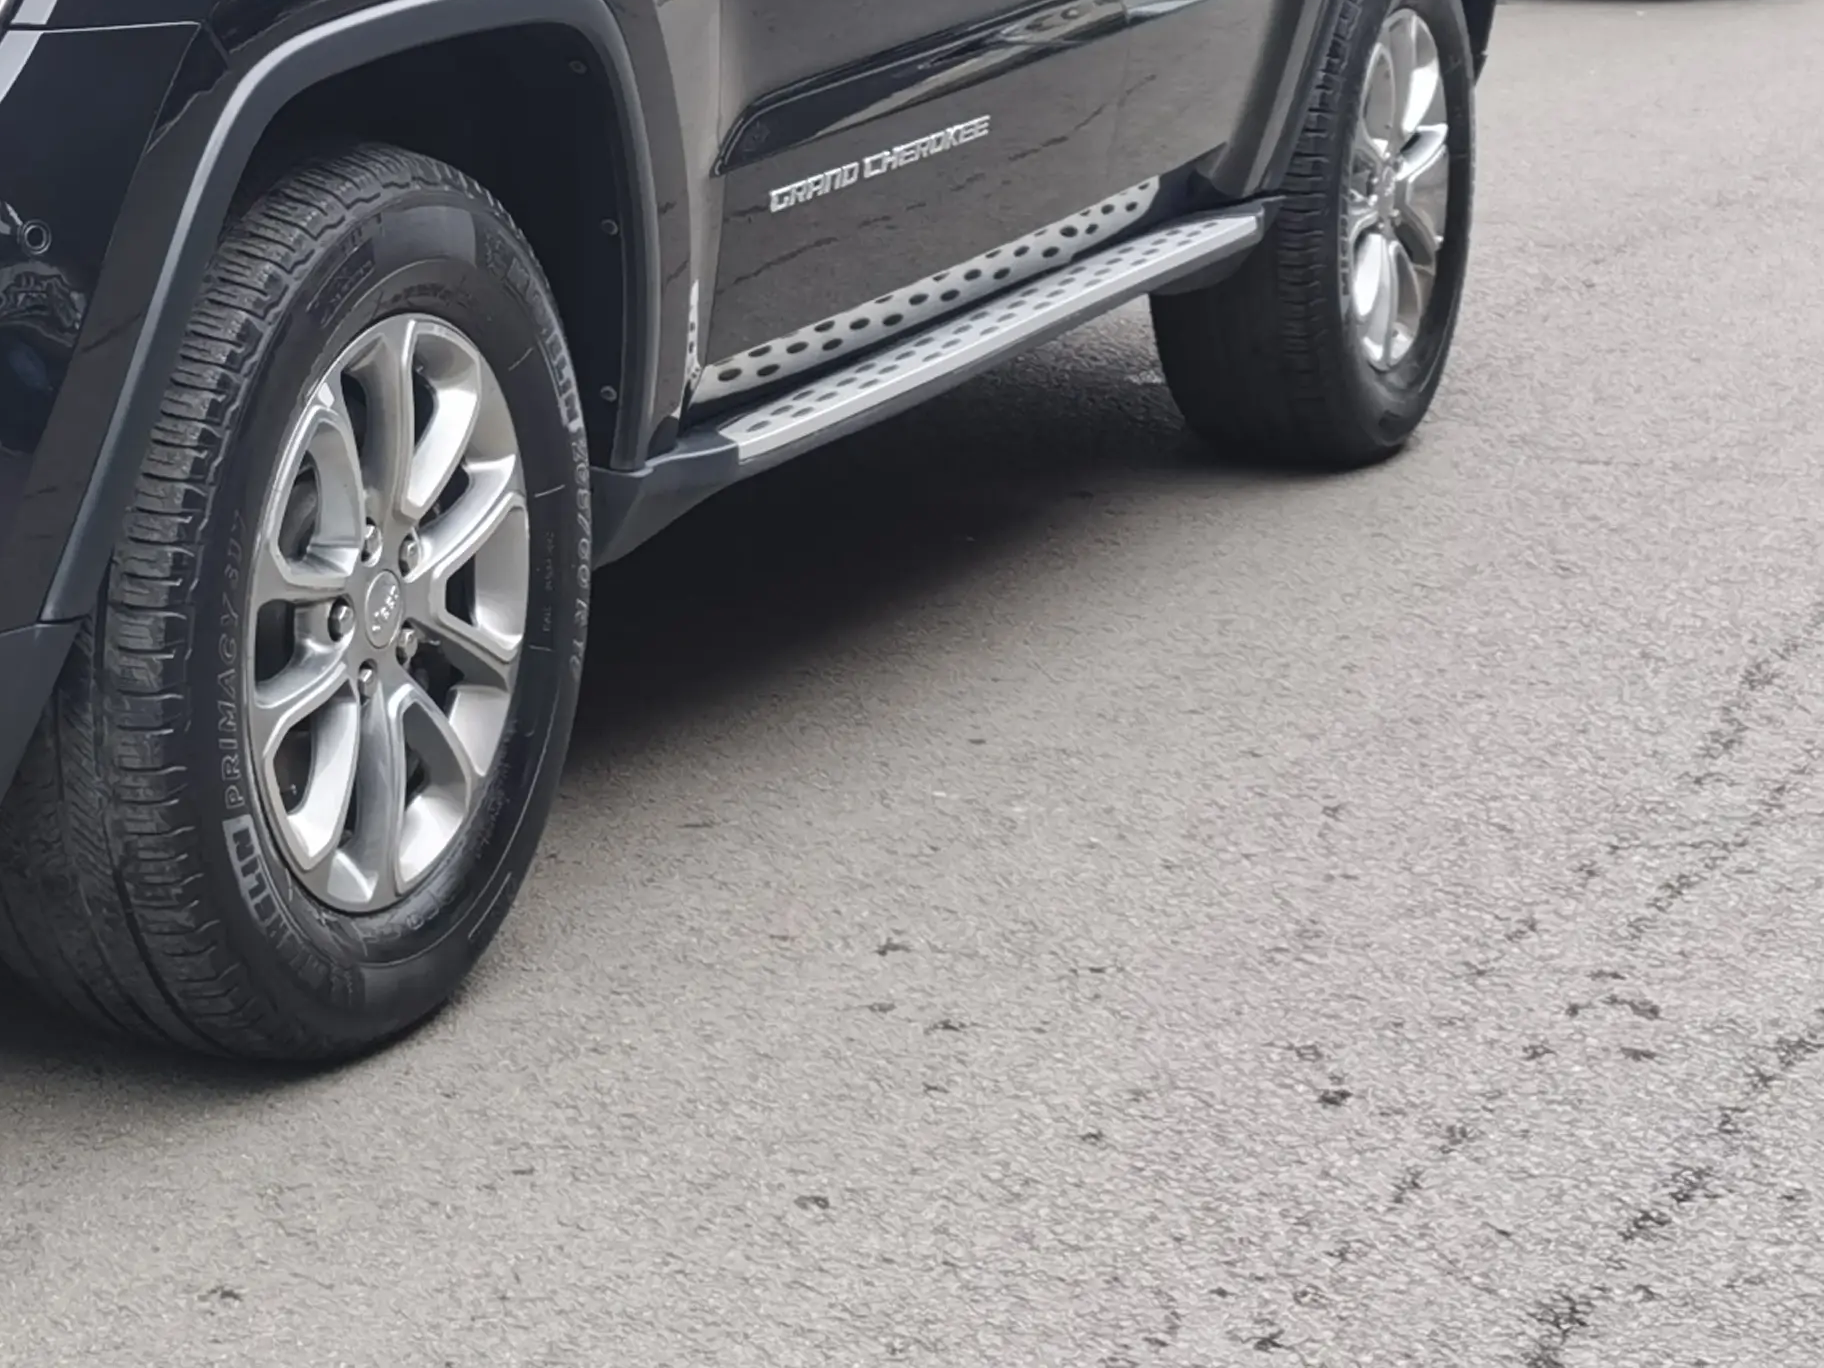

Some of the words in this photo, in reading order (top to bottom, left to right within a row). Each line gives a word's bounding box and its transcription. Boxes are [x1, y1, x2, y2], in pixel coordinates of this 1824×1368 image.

[770, 162, 859, 212] GRAND
[862, 114, 991, 179] CHEROKEE
[217, 591, 246, 810] PRIMACY
